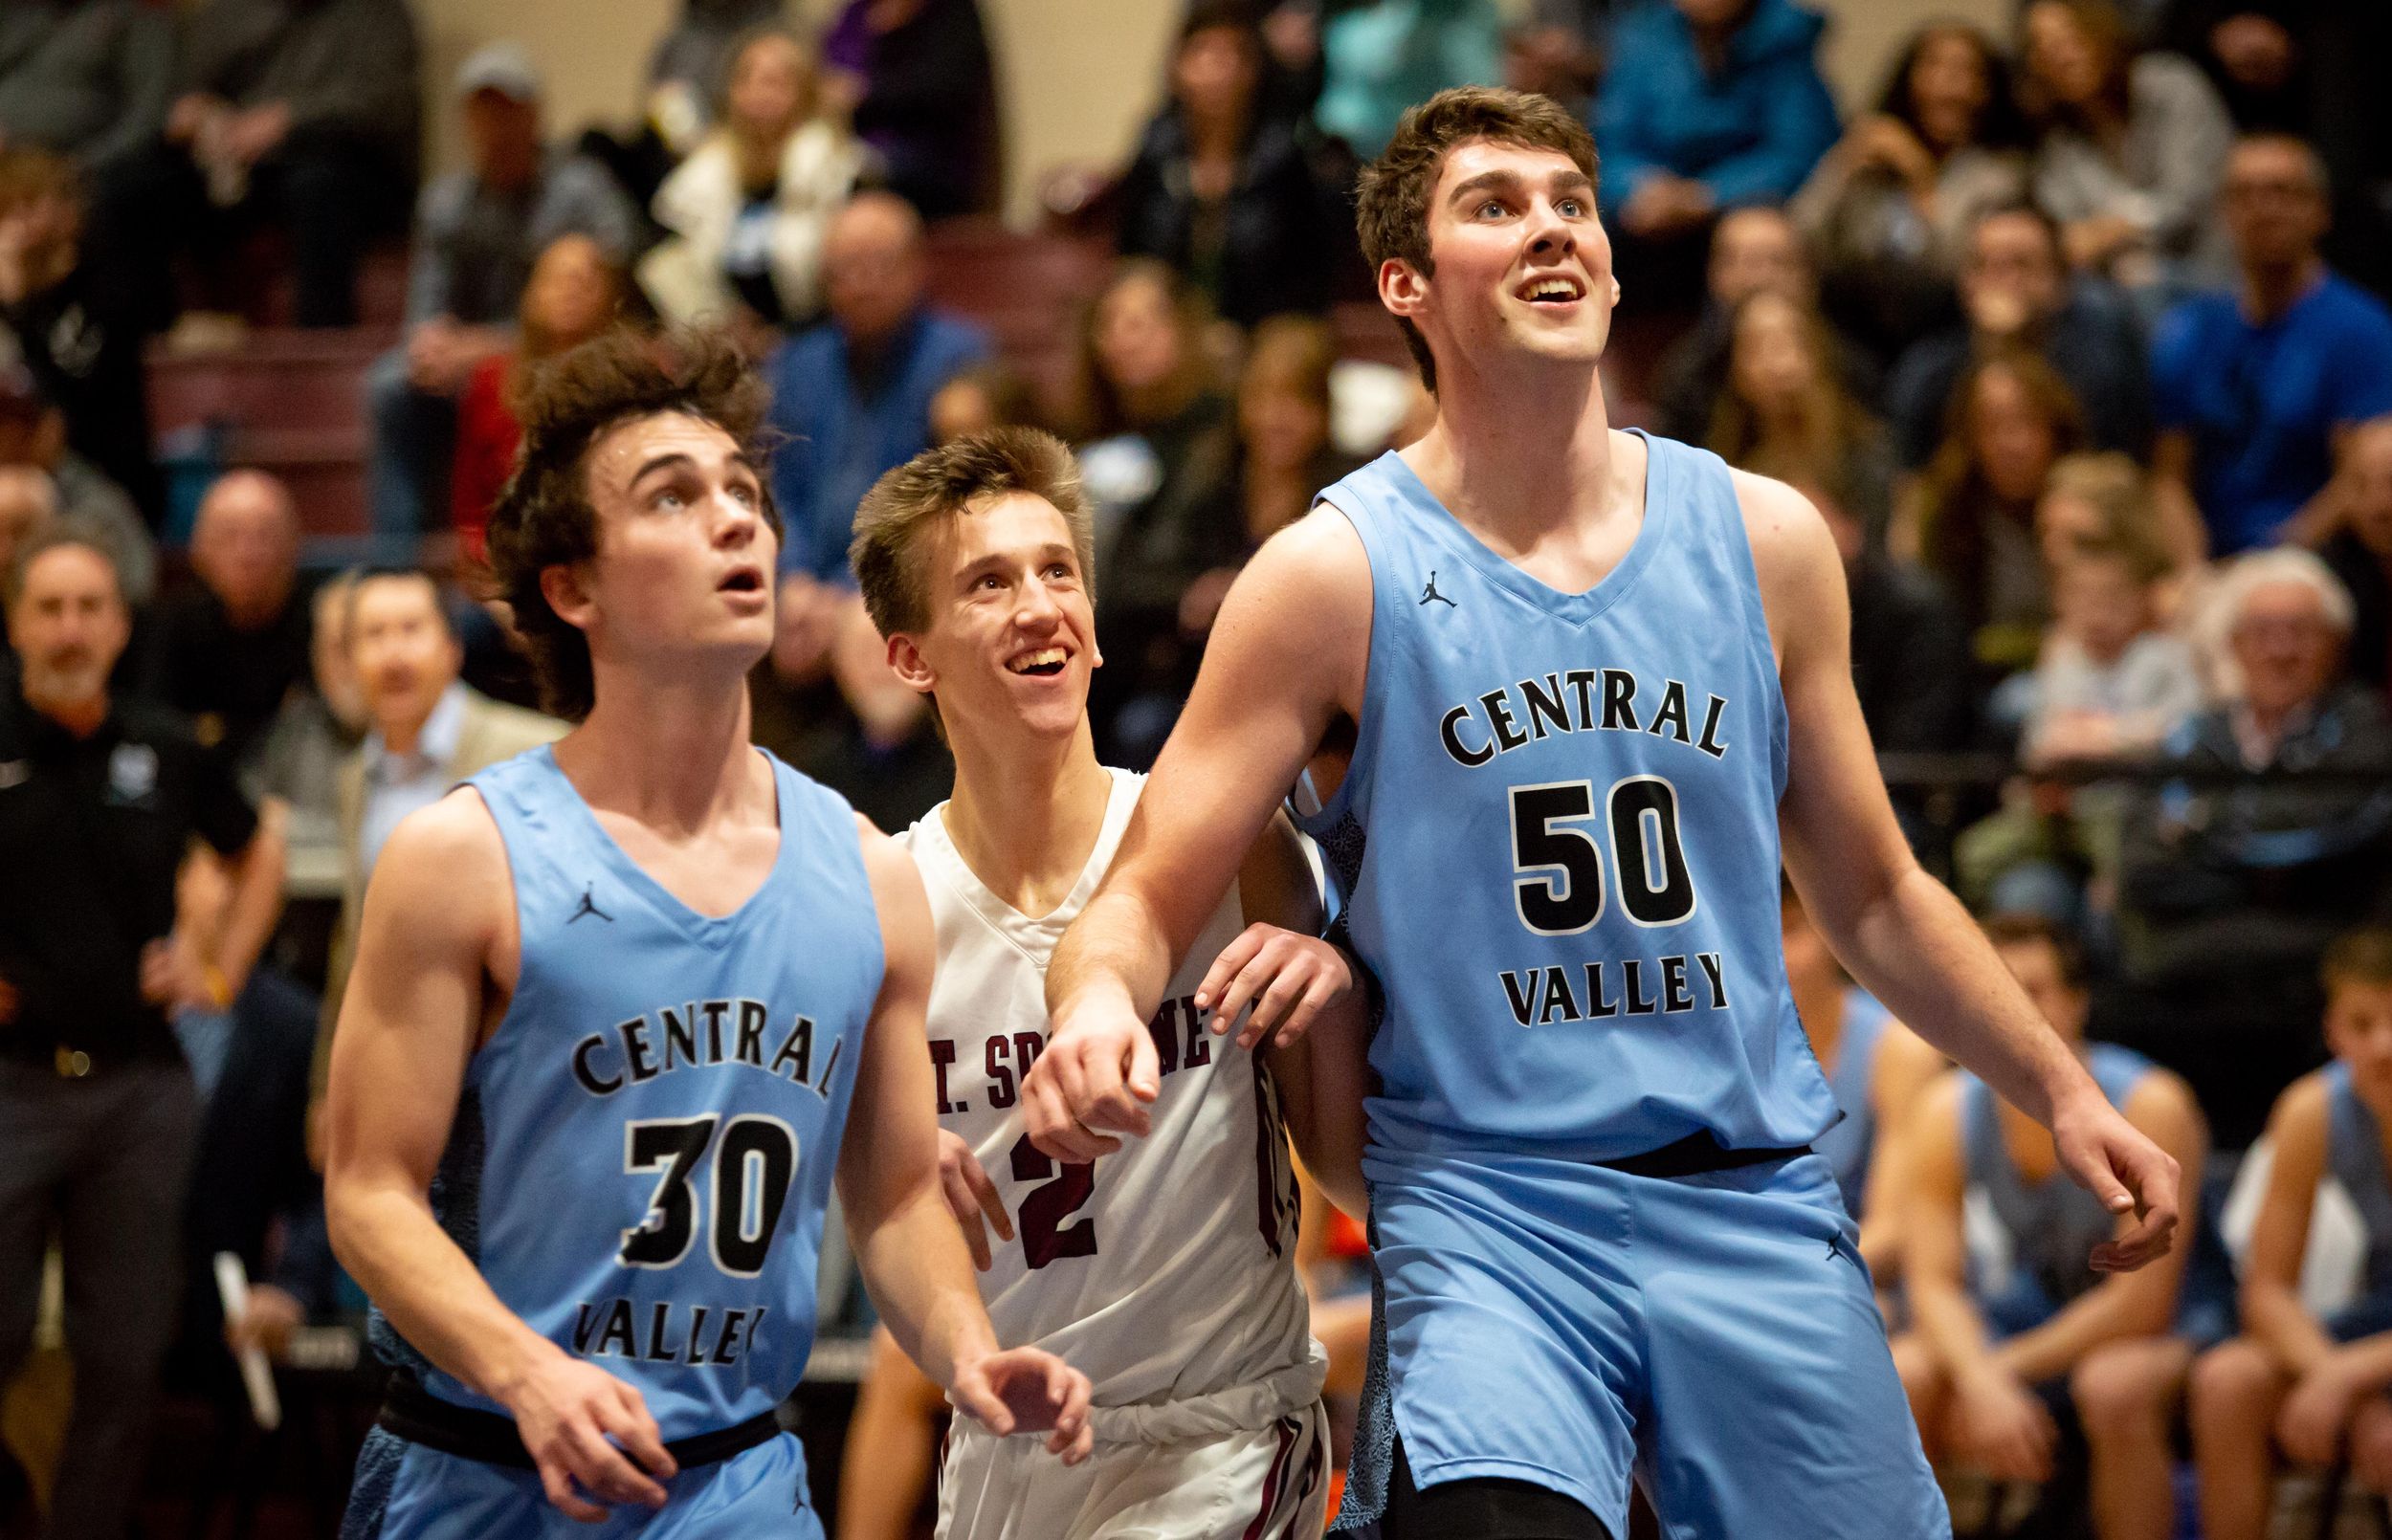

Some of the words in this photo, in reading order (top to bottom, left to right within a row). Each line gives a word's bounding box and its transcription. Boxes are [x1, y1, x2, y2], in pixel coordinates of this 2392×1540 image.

[1439, 668, 1729, 768] CENTRAL
[1508, 774, 1697, 937] 50
[1497, 952, 1729, 1028] VALLEY
[572, 998, 843, 1102] CENTRAL
[614, 1111, 800, 1279] 30
[1009, 1131, 1097, 1269] 2
[572, 1297, 768, 1366] VALLEY
